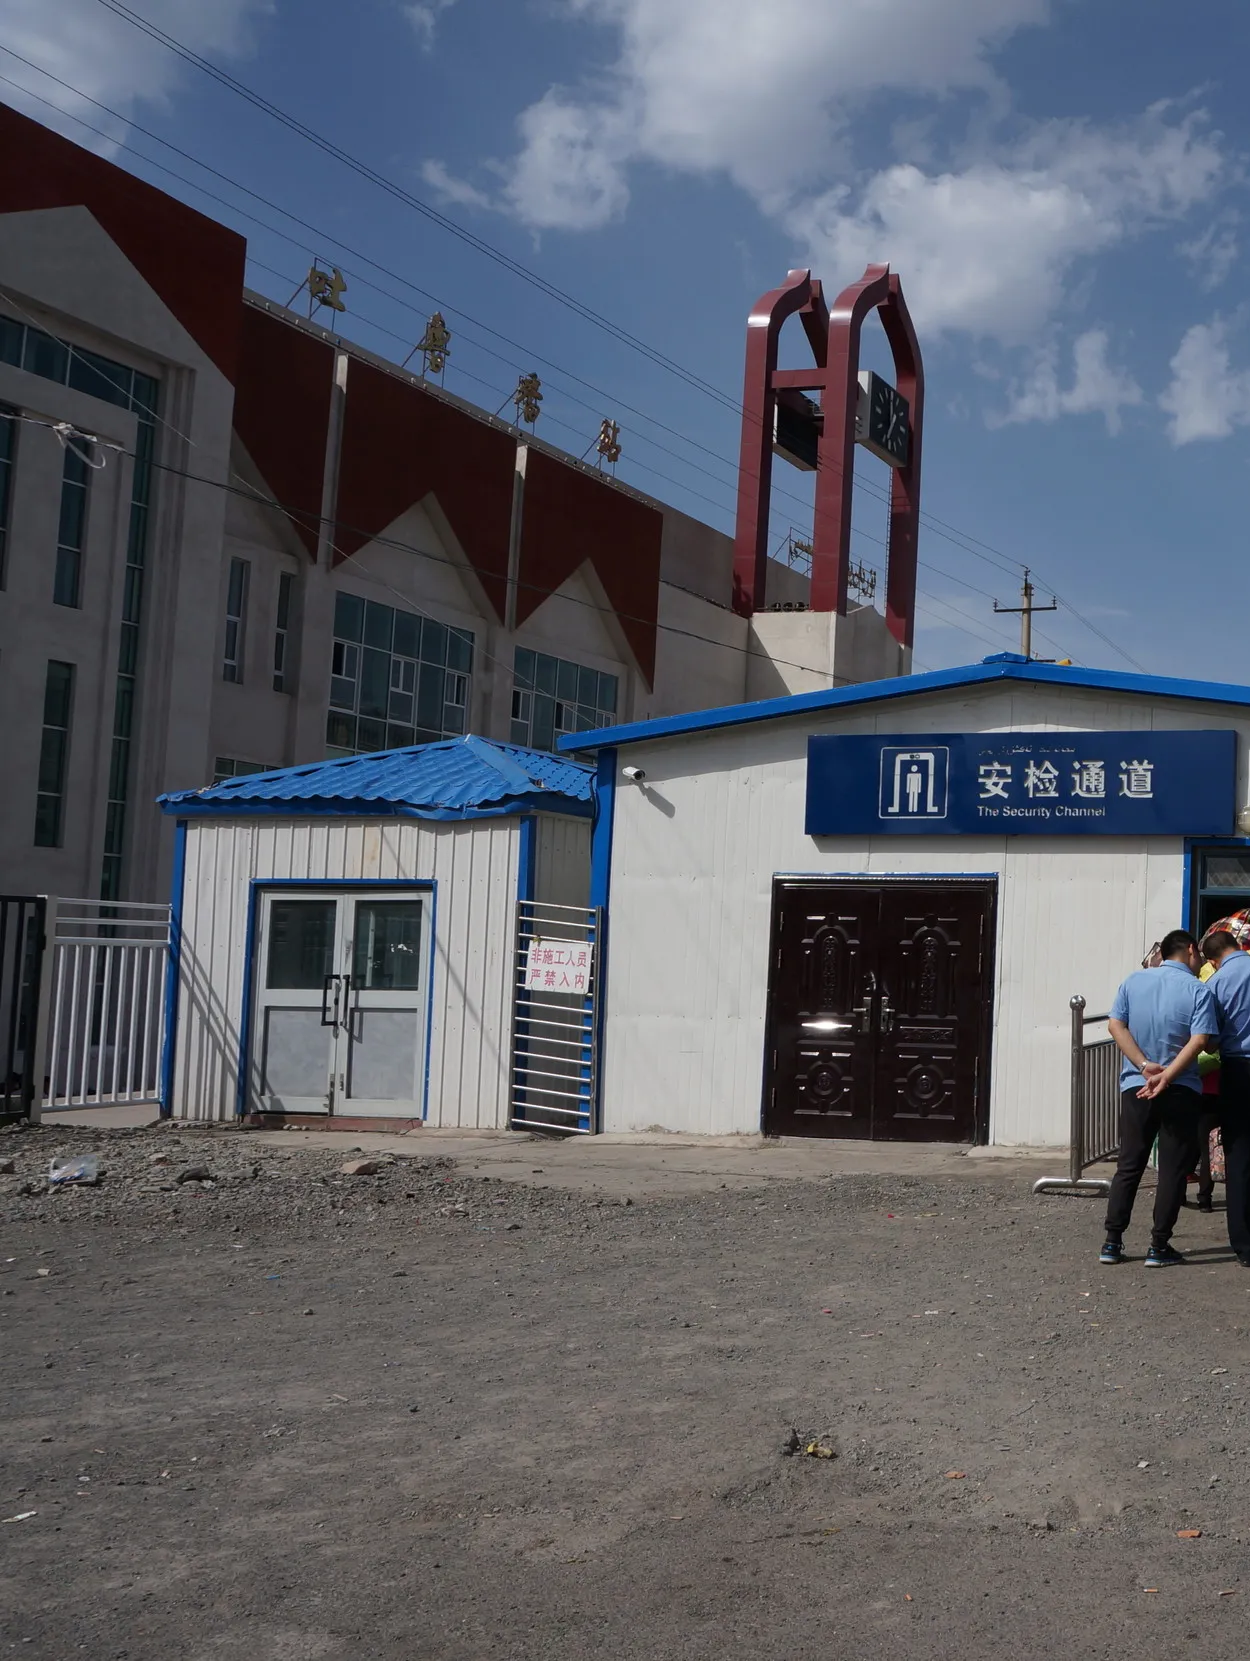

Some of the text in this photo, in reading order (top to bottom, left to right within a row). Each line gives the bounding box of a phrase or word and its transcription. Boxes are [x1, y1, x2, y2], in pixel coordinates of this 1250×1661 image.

[977, 759, 1154, 799] 安检通道
[977, 805, 1106, 820] The Security Channel
[531, 948, 587, 967] 非施工人员
[529, 968, 585, 989] 严禁入内
